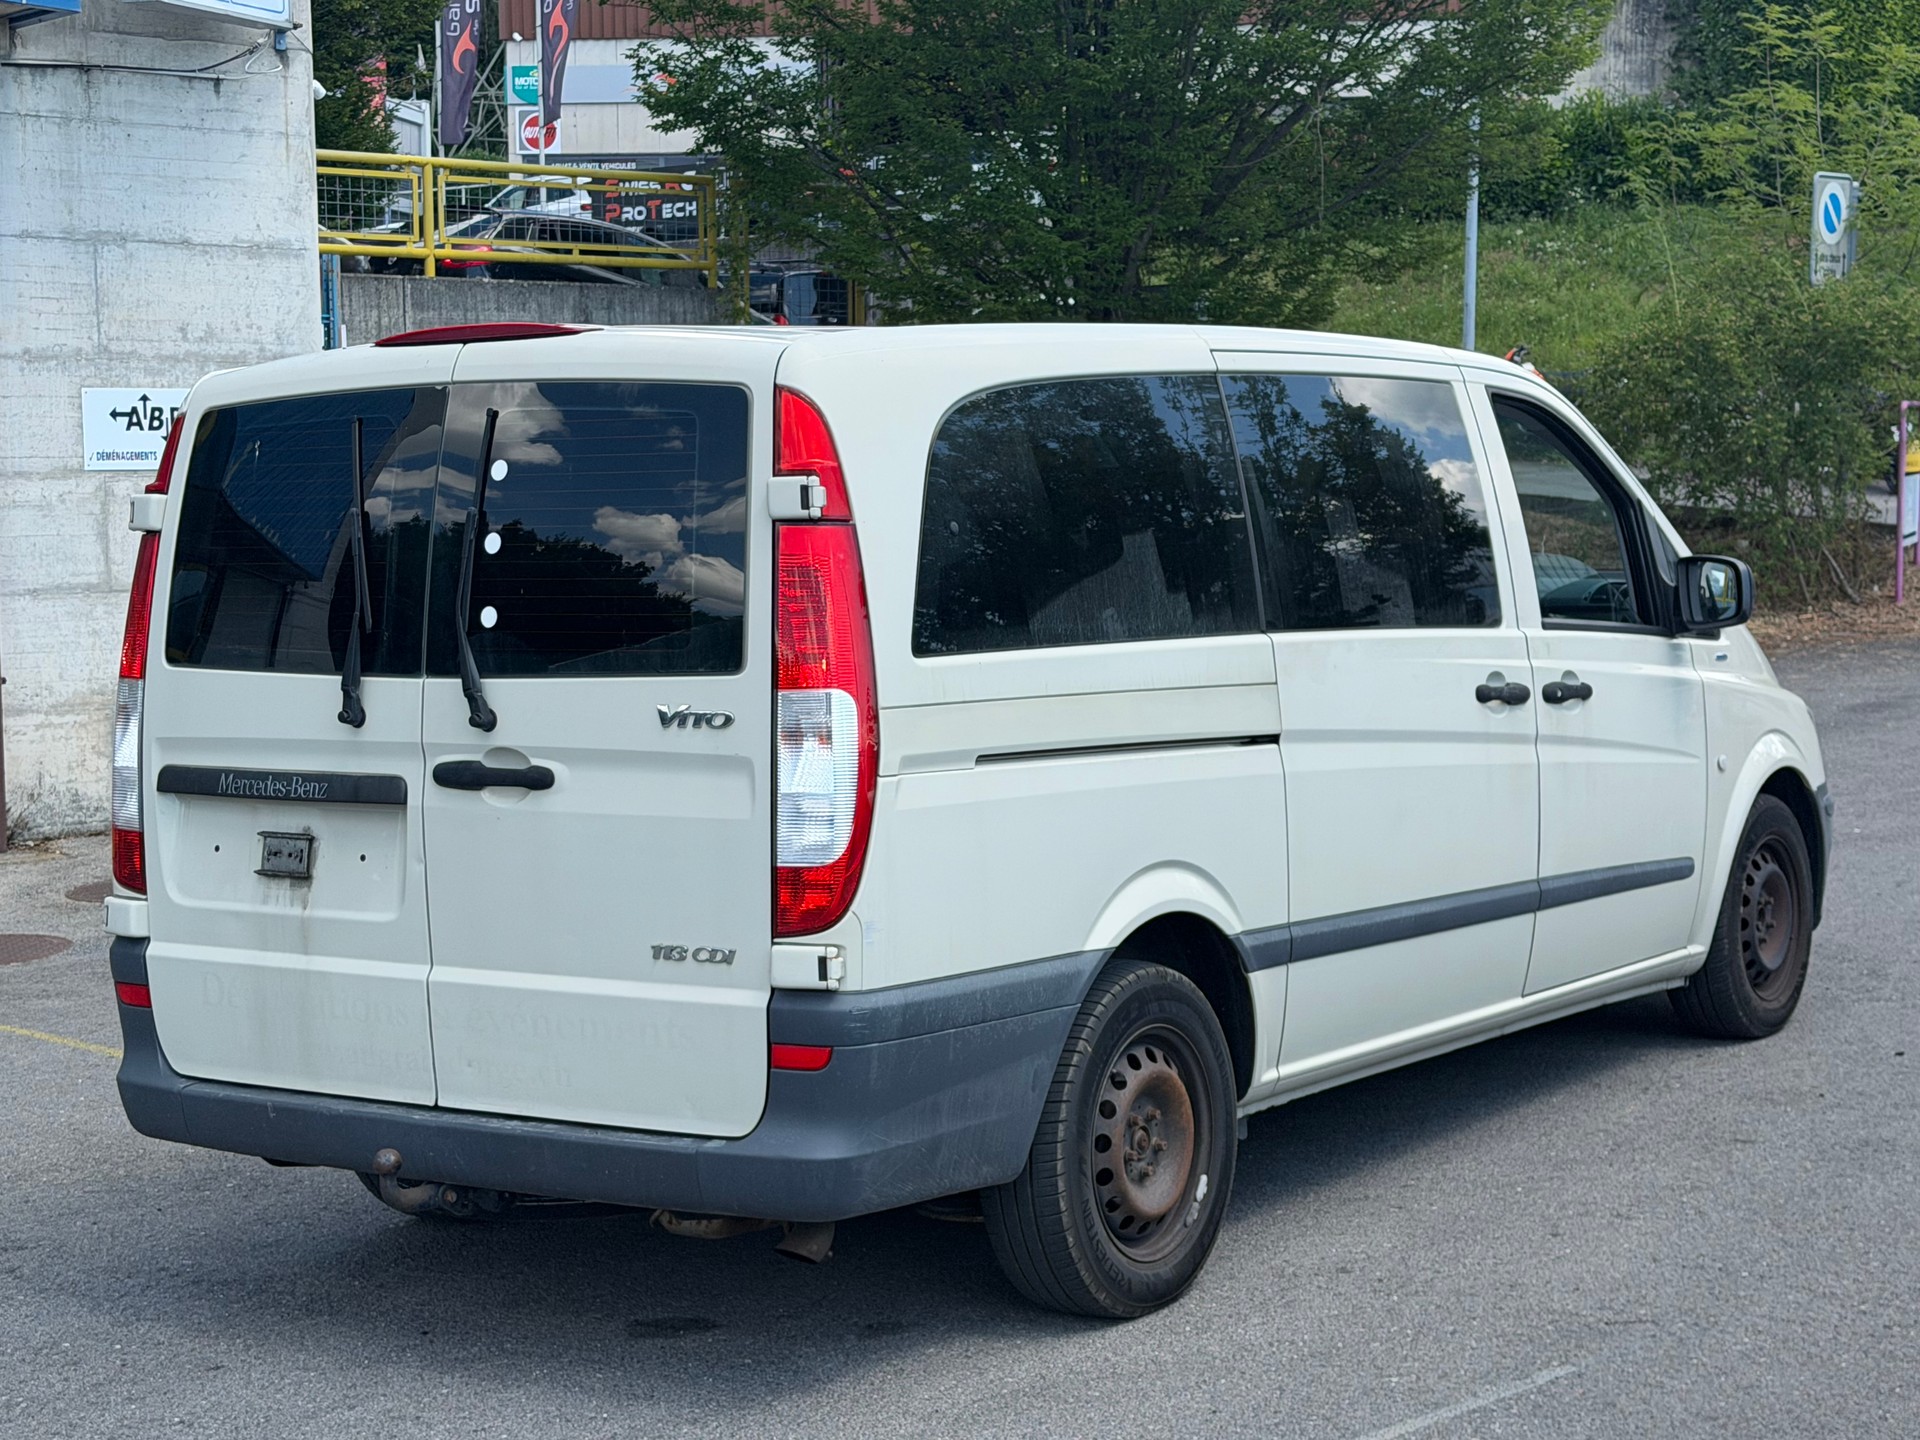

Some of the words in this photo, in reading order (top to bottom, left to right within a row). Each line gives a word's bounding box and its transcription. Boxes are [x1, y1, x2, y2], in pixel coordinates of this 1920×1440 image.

[96, 449, 158, 461] DÉMÉNAGEMENTS
[218, 772, 328, 799] Mercedes-Benz
[651, 945, 689, 962] 113
[692, 947, 736, 965] CDI
